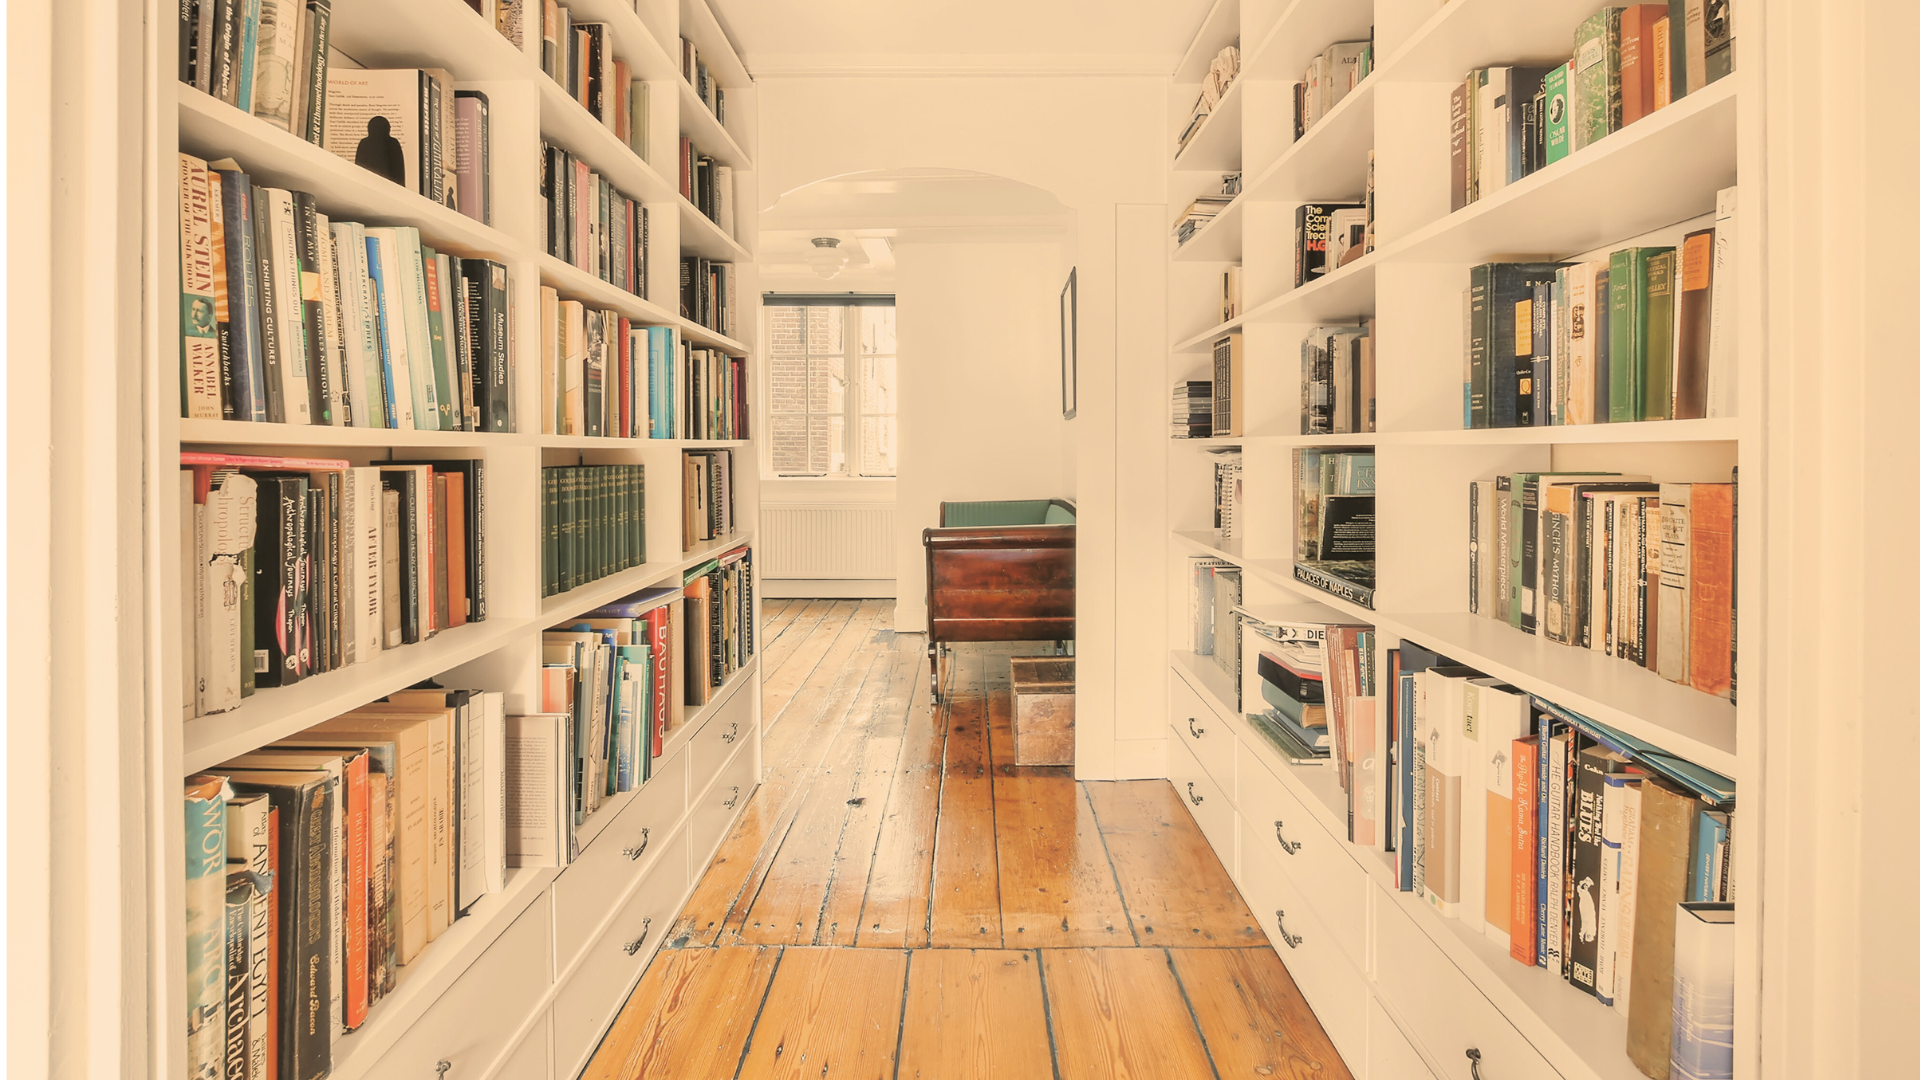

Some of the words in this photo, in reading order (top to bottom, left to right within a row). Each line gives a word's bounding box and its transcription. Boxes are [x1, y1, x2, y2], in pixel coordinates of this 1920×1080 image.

[225, 6, 234, 21] the
[223, 23, 233, 51] Origin
[223, 52, 231, 64] of
[1656, 42, 1665, 84] LAWRENCE
[221, 64, 231, 97] Objects
[1549, 126, 1566, 140] OSCAR
[1550, 134, 1566, 147] WILDE
[182, 159, 191, 201] PIONEER
[190, 161, 208, 227] AUREL
[184, 203, 191, 215] OF
[304, 206, 311, 217] IN
[1305, 205, 1323, 215] The
[286, 228, 298, 265] SORTING
[305, 220, 313, 238] THE
[194, 233, 212, 293] STEIN
[307, 240, 315, 262] MAP
[1715, 231, 1730, 272] Goethe
[242, 235, 256, 307] ROUTES
[262, 259, 274, 315] EXHIBITING
[290, 268, 300, 297] THINGS
[323, 270, 331, 293] AND
[360, 268, 370, 310] AIRCRAFT
[292, 299, 300, 316] OUT
[1557, 306, 1565, 326] How
[266, 317, 277, 366] CULTURES
[316, 308, 325, 352] CHARLES
[364, 314, 373, 351] STORIES
[497, 312, 506, 351] Museum
[192, 343, 205, 395] WALKER
[203, 343, 217, 400] ANNABEL
[220, 329, 232, 387] Switchbacks
[498, 352, 506, 386] Studies
[320, 355, 329, 400] NICHOLL
[369, 484, 377, 512] Stocking
[1499, 498, 1508, 530] World
[283, 496, 297, 561] Anthropological
[299, 495, 307, 556] Anthropological
[331, 518, 339, 567] Anthropology
[368, 527, 378, 570] AFTER
[1498, 532, 1508, 601] Masterpieces
[285, 562, 297, 598] Journeys
[299, 558, 307, 592] Journeys
[332, 575, 340, 603] Cultural
[1296, 568, 1321, 585] PALACES
[1320, 577, 1329, 589] OF
[1329, 581, 1354, 600] NAPLES
[368, 572, 378, 618] TYLOR
[331, 603, 340, 631] Critique
[1307, 629, 1325, 640] DIE
[658, 625, 667, 741] BAUHAUS
[1465, 691, 1476, 734] Koentact
[1517, 764, 1528, 795] Pop-Up
[1517, 797, 1528, 825] Kama
[1550, 782, 1562, 820] GUITAR
[1578, 789, 1595, 844] BLUES
[1593, 794, 1604, 820] Nothing
[260, 811, 268, 836] Atlas
[1517, 825, 1528, 850] Sutra
[1593, 834, 1603, 847] the
[1594, 820, 1603, 833] But
[1627, 807, 1636, 843] GRAHAM
[332, 825, 341, 877] Information:
[355, 811, 364, 887] PREHISTORIC
[1549, 822, 1562, 881] HANDBOOK
[252, 844, 268, 943] ANIENT
[333, 878, 341, 894] The
[373, 864, 386, 909] hunter
[1549, 881, 1561, 911] RALPH
[1619, 853, 1634, 914] BARNS
[333, 896, 341, 923] Hidden
[1539, 903, 1547, 921] Cherry
[227, 910, 238, 963] Encyclopedia
[236, 921, 245, 965] Cambridge
[355, 903, 364, 954] ANCIENT
[1549, 911, 1560, 948] DENYER
[252, 948, 268, 1020] EGYPT
[309, 952, 321, 998] Edward
[355, 958, 363, 983] ART
[1686, 981, 1695, 1008] Mapping
[309, 999, 320, 1036] Bacon
